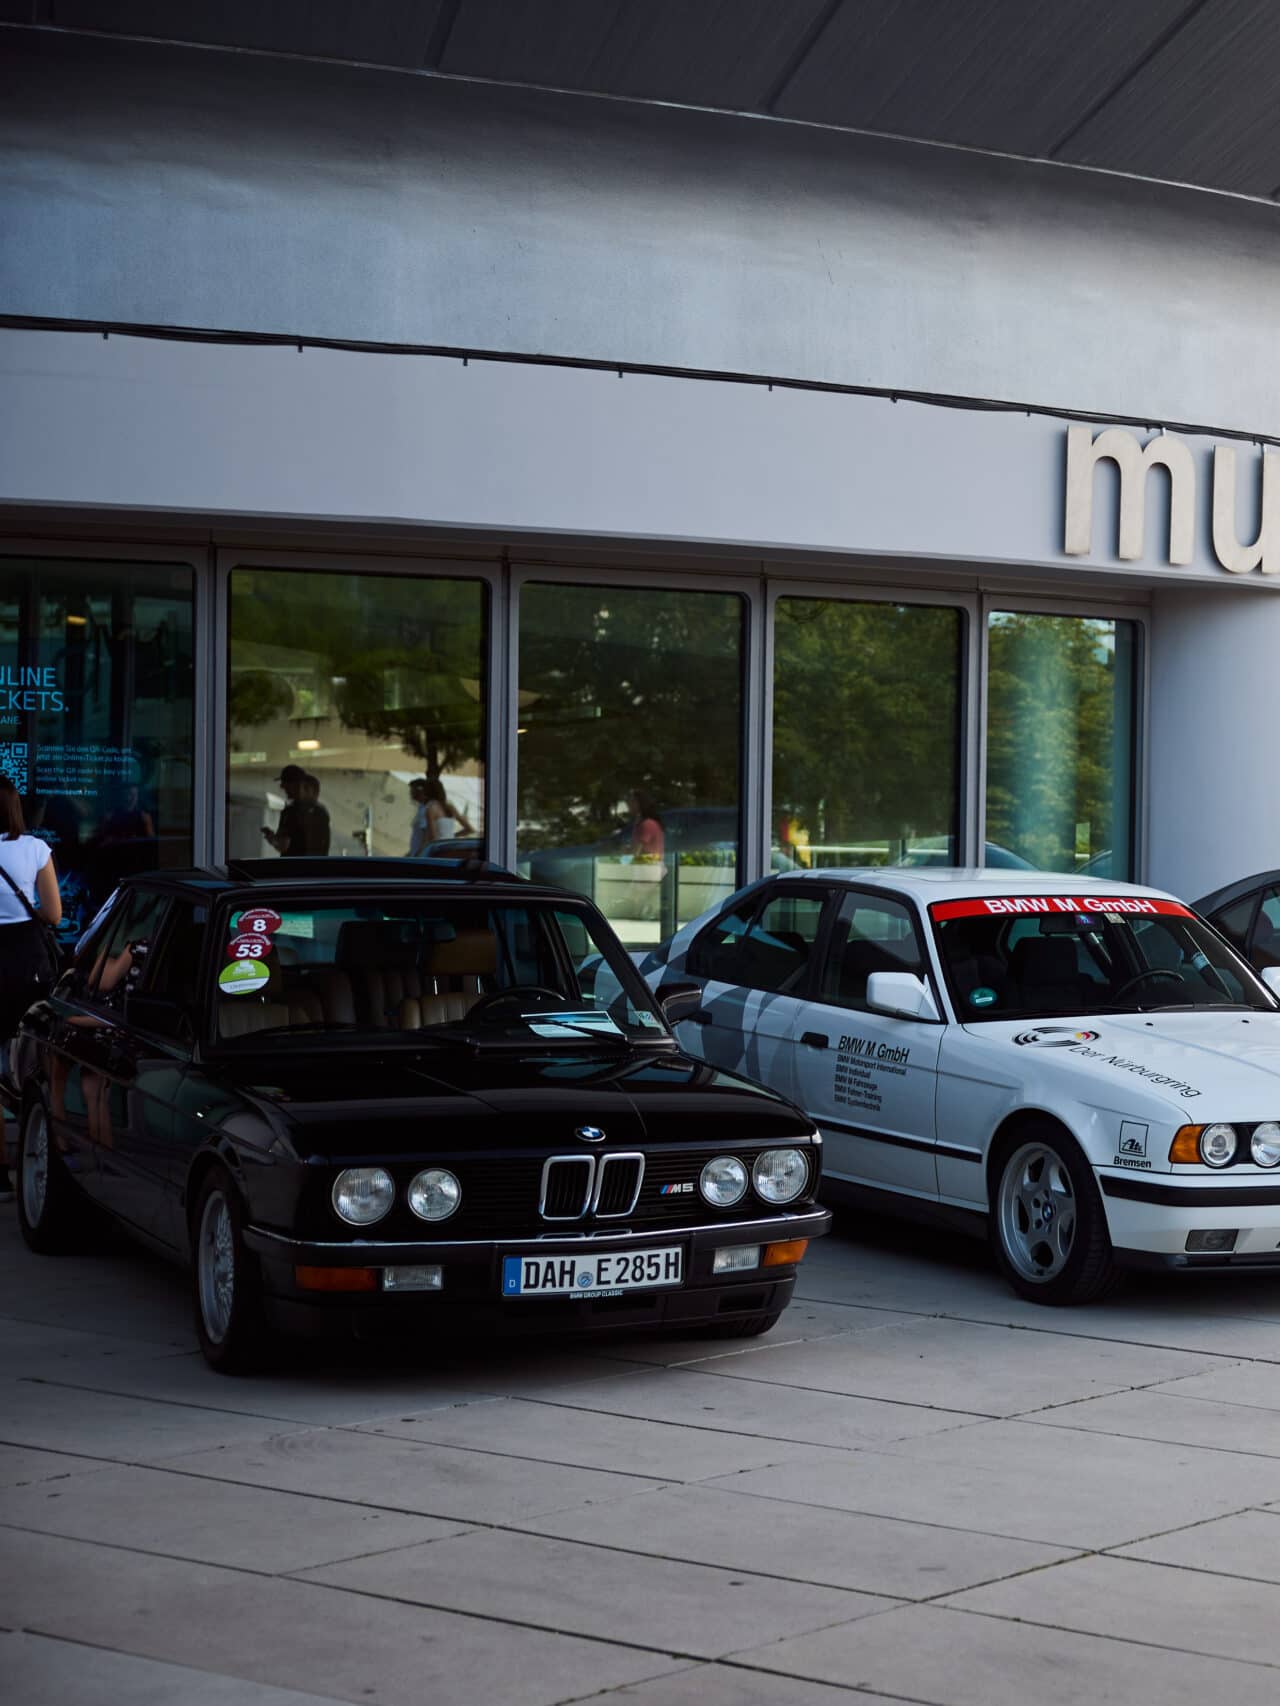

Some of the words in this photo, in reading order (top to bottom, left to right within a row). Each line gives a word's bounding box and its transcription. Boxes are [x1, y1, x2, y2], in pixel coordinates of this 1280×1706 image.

[984, 899, 1049, 914] BMW
[1052, 899, 1081, 912] M
[1083, 898, 1159, 913] GmbH
[252, 919, 267, 932] 8
[235, 944, 263, 957] 53
[838, 1035, 866, 1054] BMW
[865, 1041, 876, 1056] M
[877, 1043, 910, 1063] GmbH
[1068, 1046, 1104, 1059] Der
[1102, 1055, 1202, 1098] Nürburgring
[1113, 1156, 1151, 1168] Bremsen
[670, 1183, 694, 1194] M5
[523, 1260, 576, 1289] DAH
